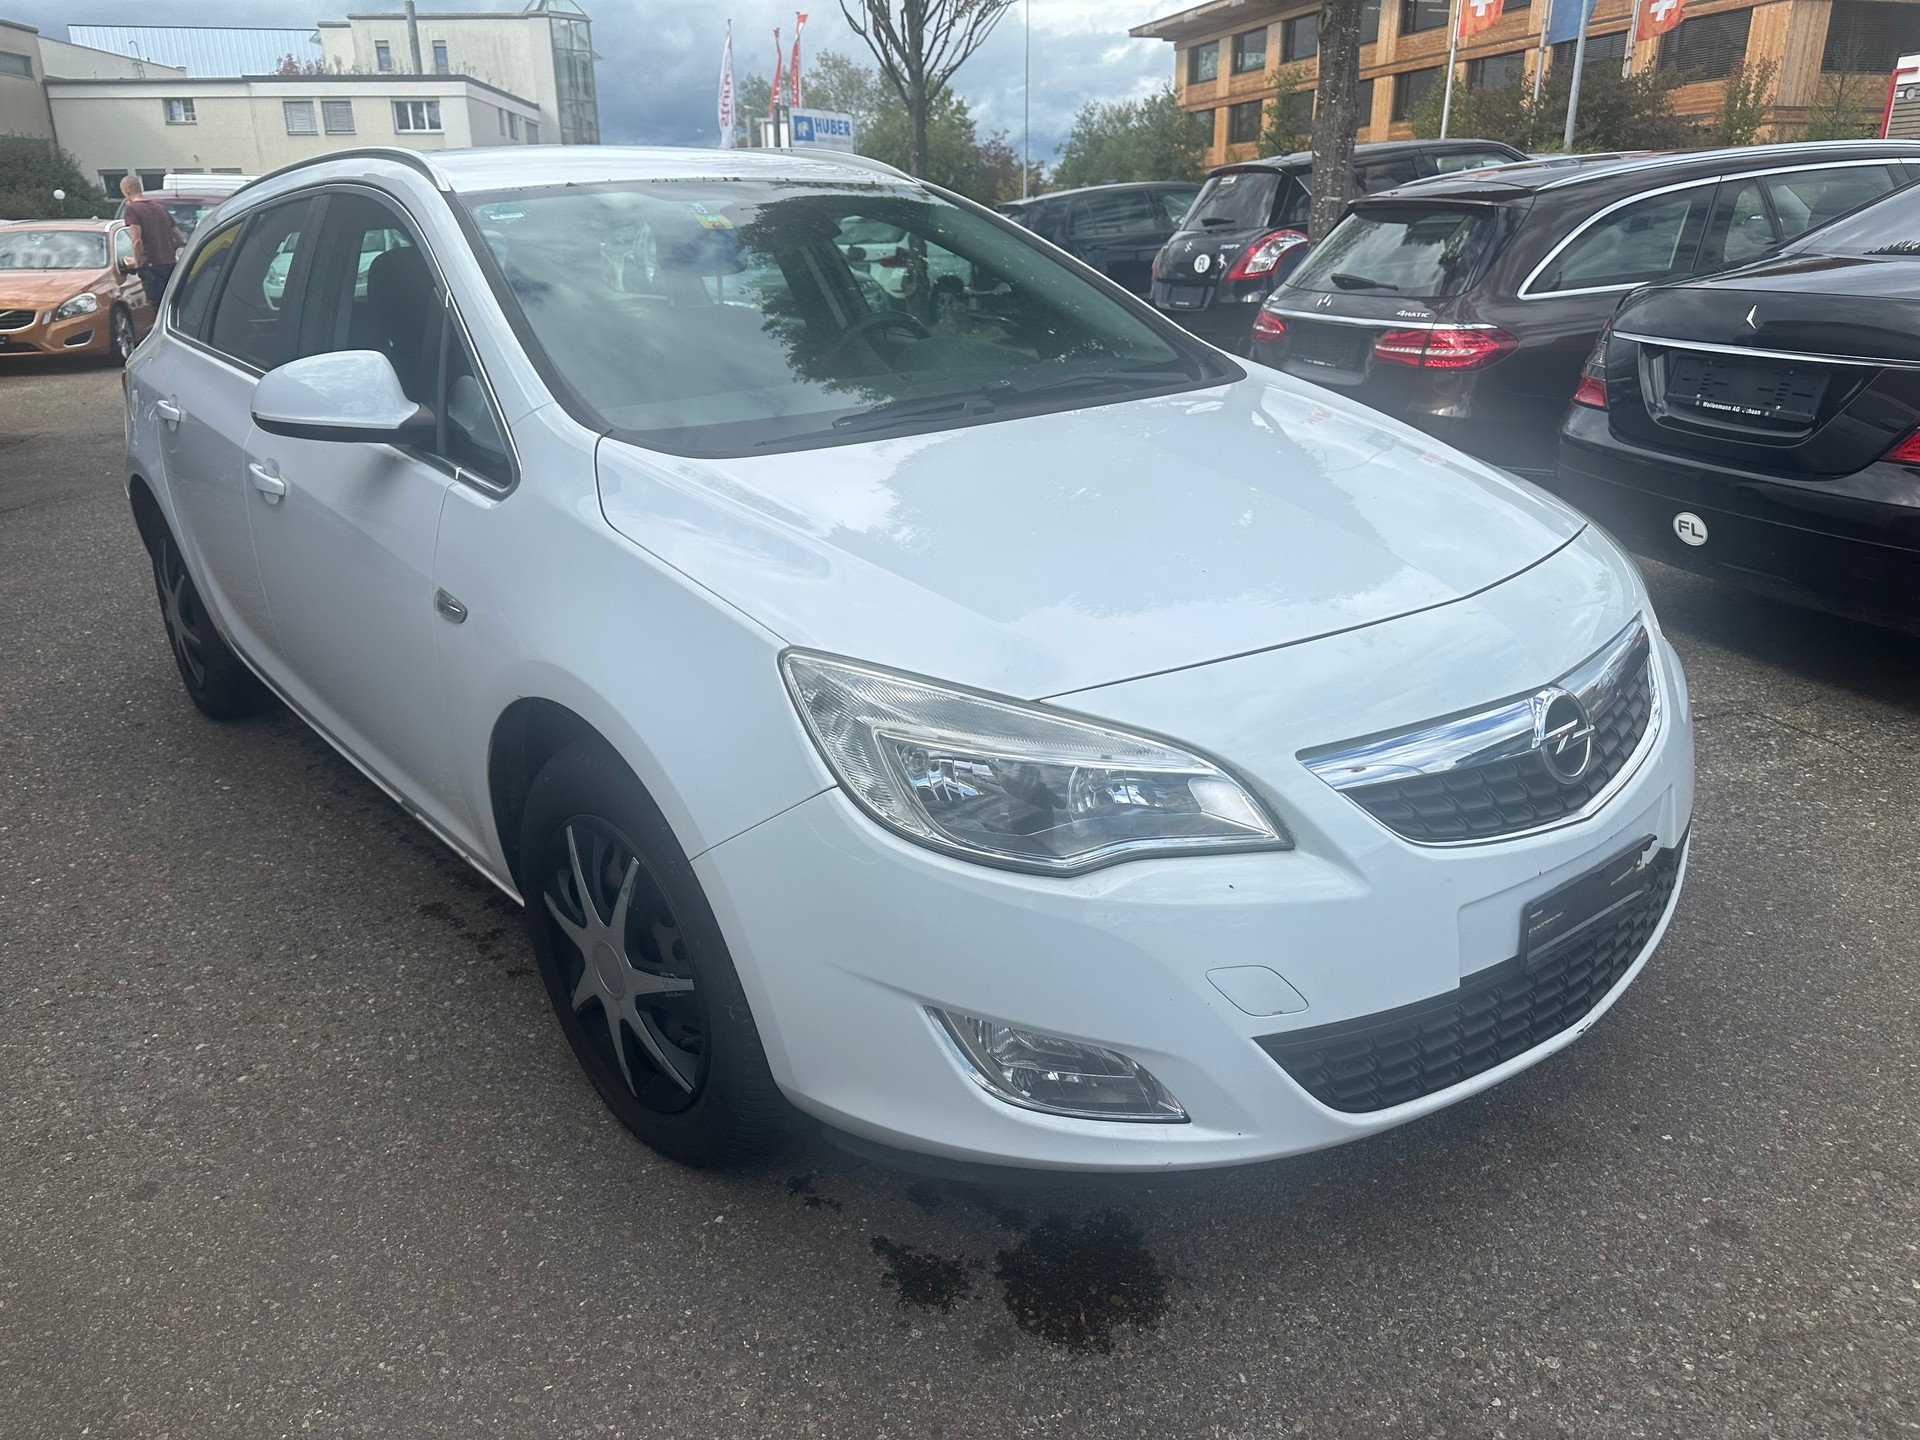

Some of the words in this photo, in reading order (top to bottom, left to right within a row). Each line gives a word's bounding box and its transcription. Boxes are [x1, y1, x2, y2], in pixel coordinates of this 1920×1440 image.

[814, 117, 851, 136] HUBER
[1396, 310, 1430, 318] 4MATIC
[1678, 519, 1704, 539] FL
